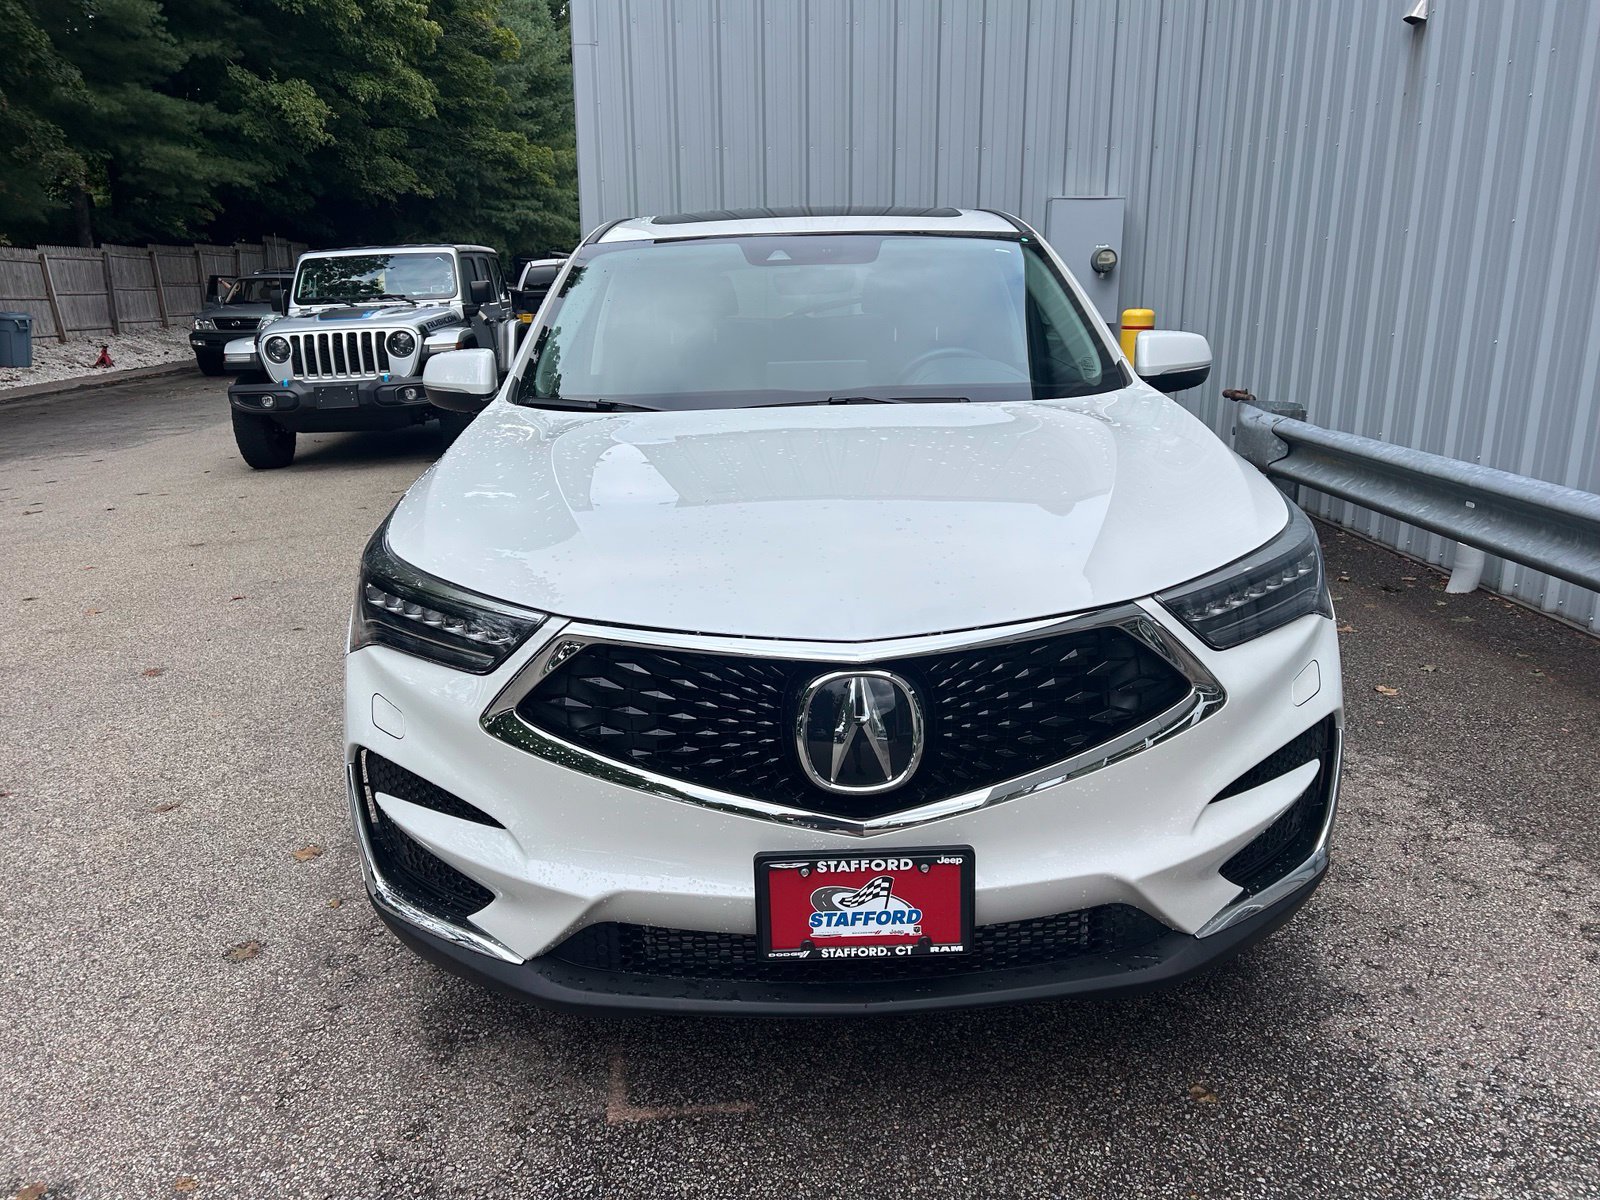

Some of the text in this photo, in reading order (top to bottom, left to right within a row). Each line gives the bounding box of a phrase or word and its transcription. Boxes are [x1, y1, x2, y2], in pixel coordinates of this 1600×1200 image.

[426, 314, 457, 329] RUBICON
[816, 858, 914, 873] STAFFORD
[936, 855, 963, 866] Jeep
[809, 908, 922, 928] STAFFORD
[895, 945, 913, 956] CT
[930, 945, 963, 953] RAM
